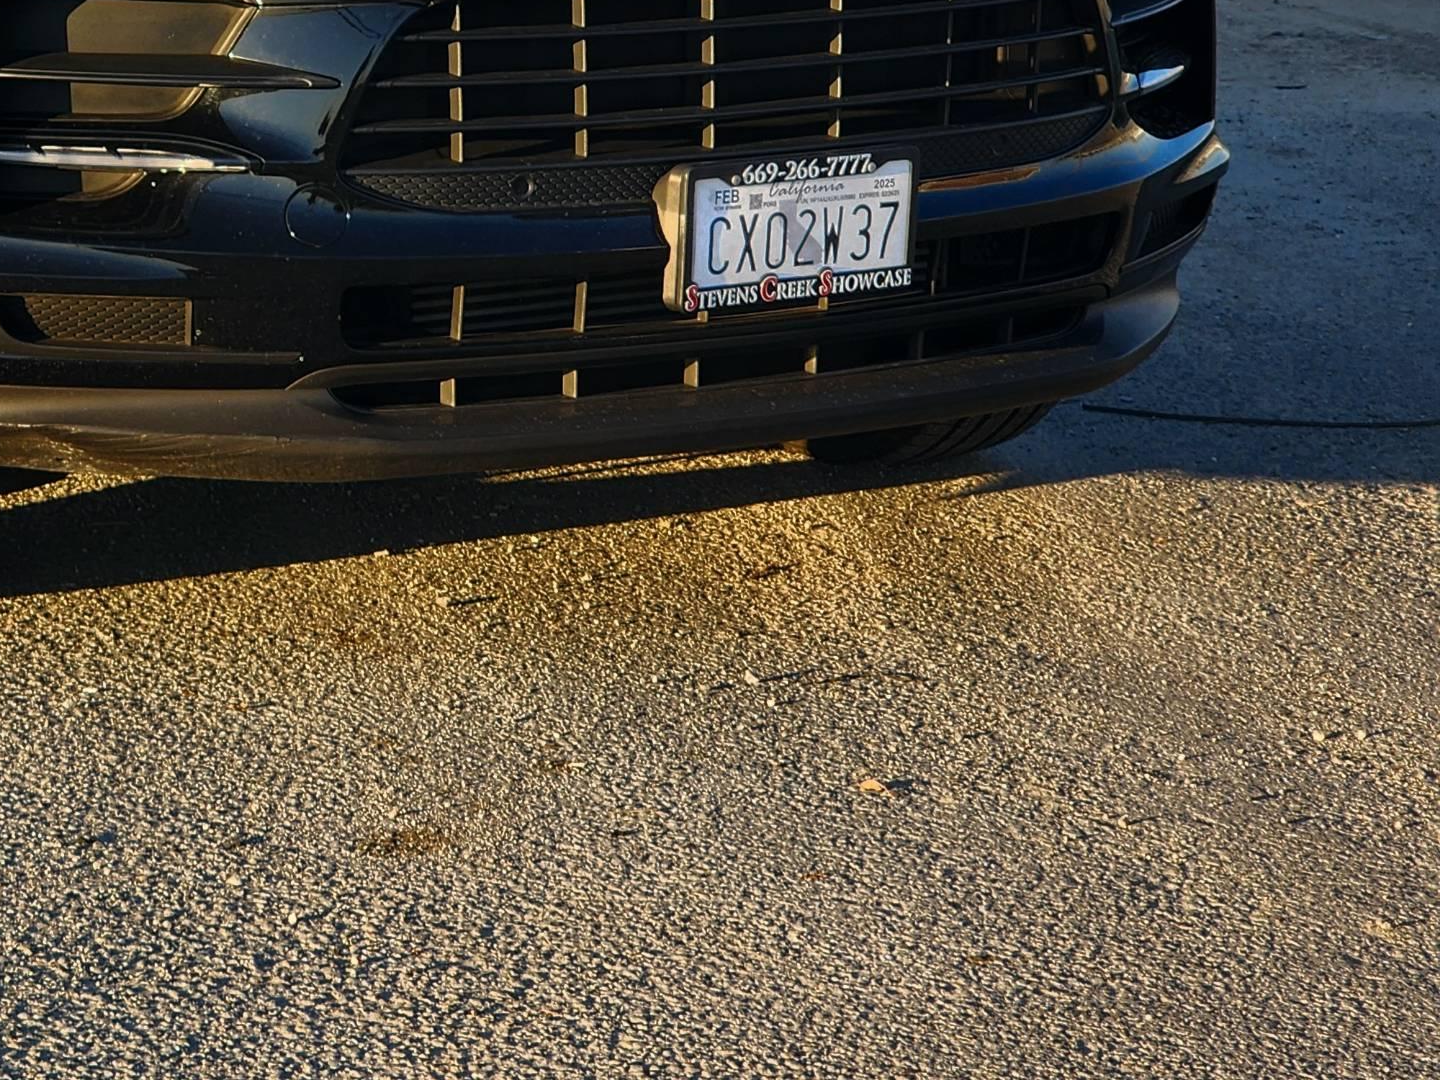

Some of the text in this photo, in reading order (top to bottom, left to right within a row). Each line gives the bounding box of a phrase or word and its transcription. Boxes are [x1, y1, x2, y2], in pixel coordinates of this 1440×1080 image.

[742, 153, 872, 185] 669-266-7777
[714, 189, 740, 204] FEB
[769, 180, 845, 204] California
[873, 178, 896, 190] 2025
[708, 201, 900, 275] CX02W37
[684, 267, 912, 312] STEVENS CREEK SHOWCASE
